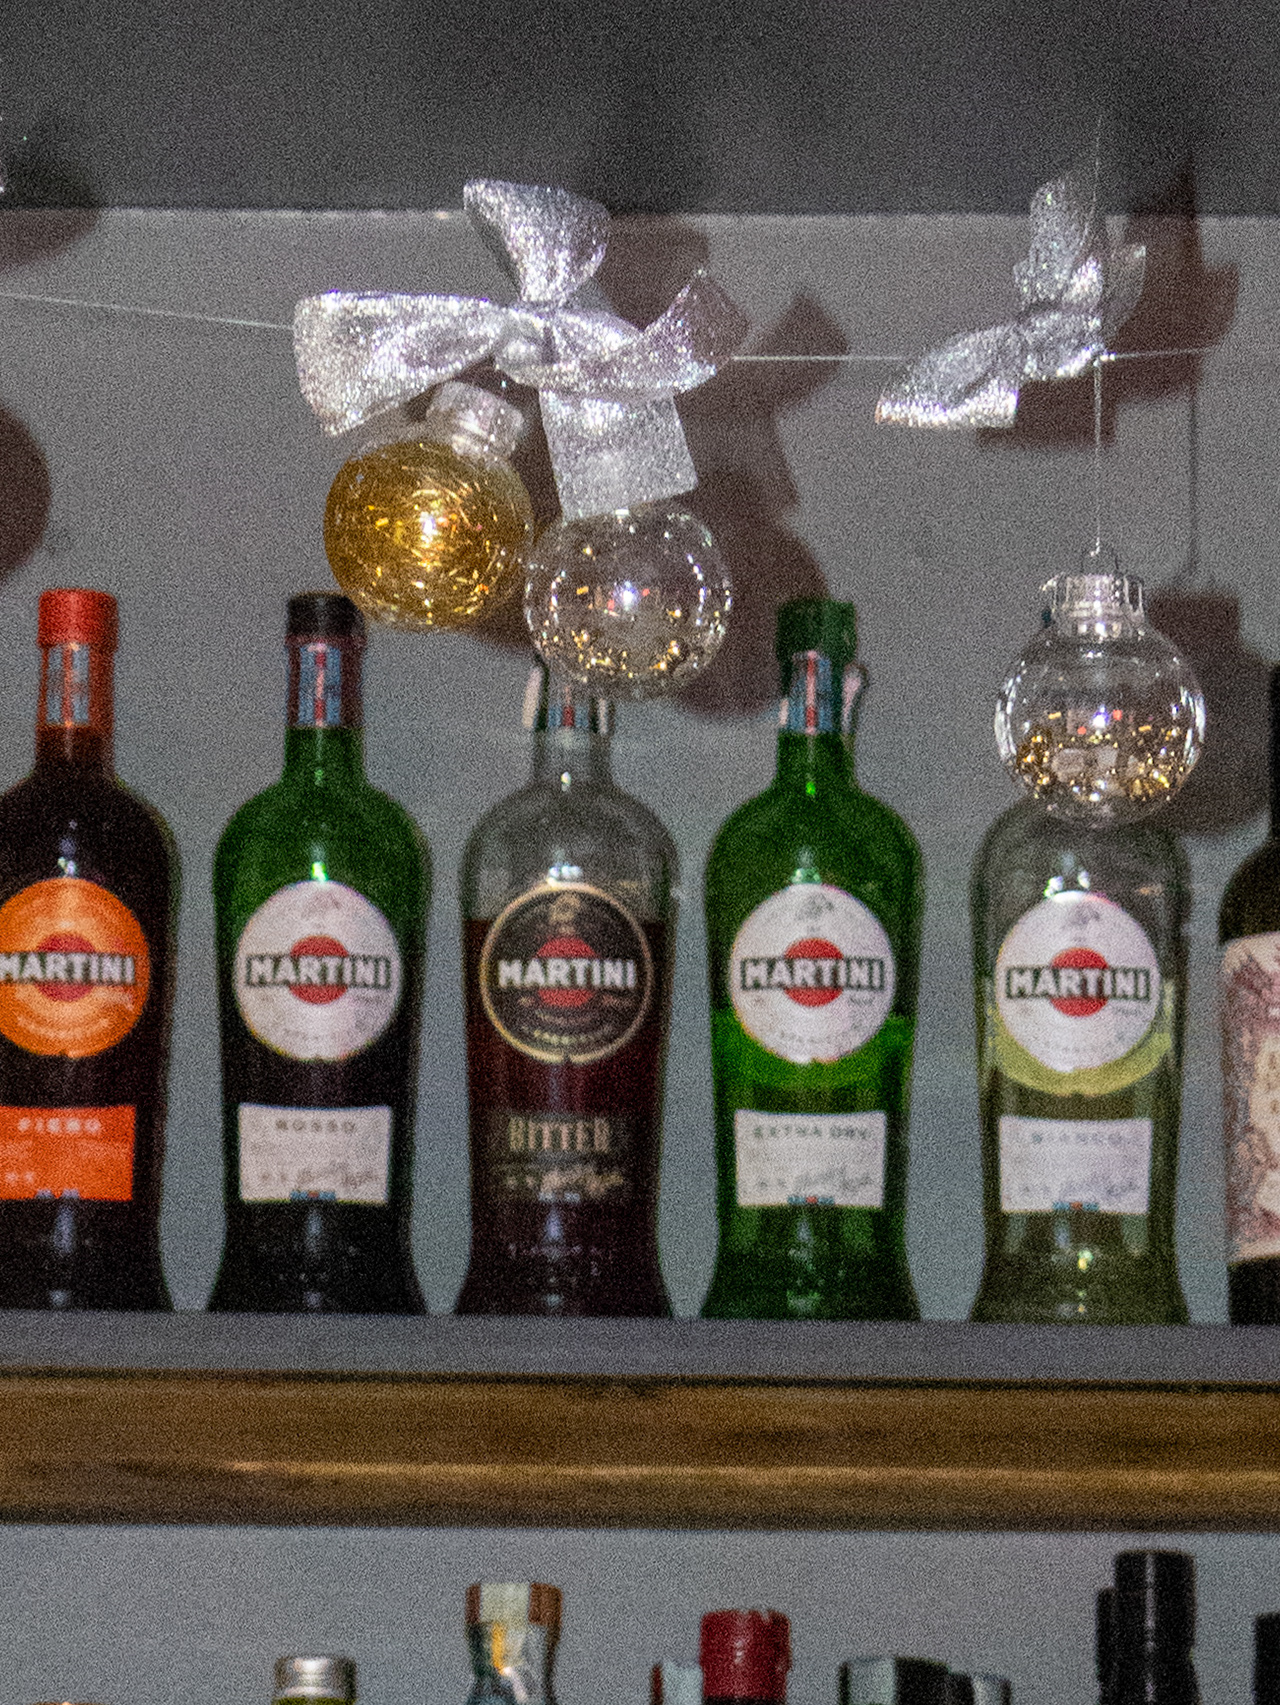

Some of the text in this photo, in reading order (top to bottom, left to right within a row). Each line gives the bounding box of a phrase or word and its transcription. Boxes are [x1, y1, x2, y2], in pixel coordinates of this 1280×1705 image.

[249, 955, 389, 987] MARTINI
[497, 958, 637, 990] MARTINI
[745, 959, 882, 990] MARTINI
[1009, 967, 1150, 1000] MARTINI
[275, 1118, 358, 1135] ROSSO
[508, 1116, 610, 1152] BITTER
